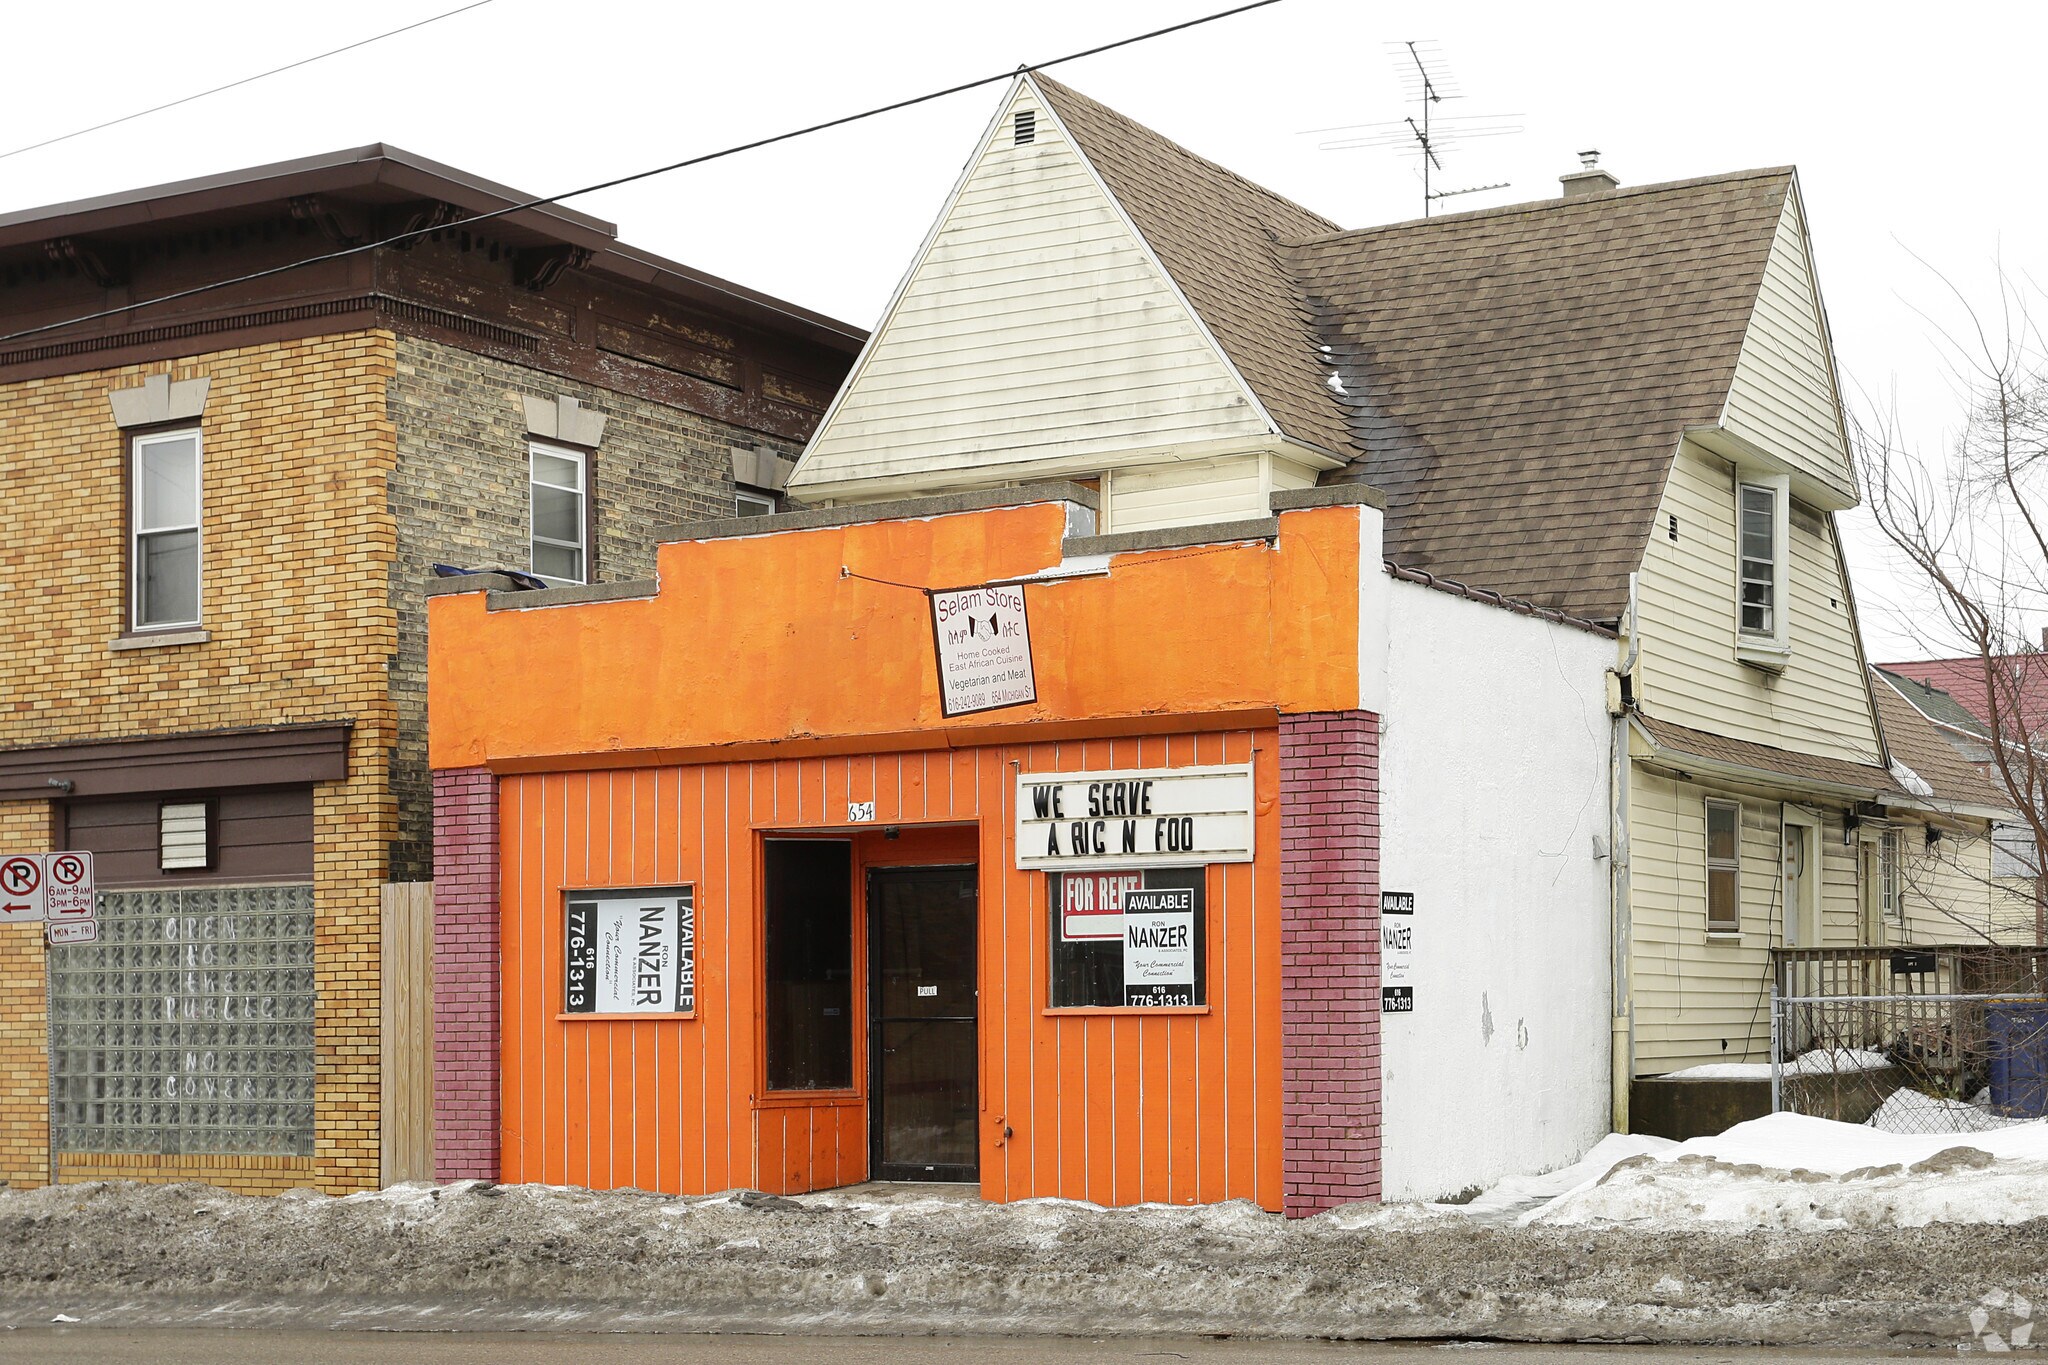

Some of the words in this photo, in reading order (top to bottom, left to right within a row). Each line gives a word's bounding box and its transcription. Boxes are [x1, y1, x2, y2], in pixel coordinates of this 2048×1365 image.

[938, 592, 982, 622] Selam
[985, 588, 1022, 612] Store
[949, 662, 966, 672] East
[968, 658, 994, 669] African
[996, 654, 1023, 665] Cuisine
[957, 651, 980, 661] Home
[981, 645, 1010, 657] Cooked
[949, 676, 990, 692] Vegetarian
[992, 672, 1006, 683] and
[1007, 668, 1027, 681] Meat
[991, 690, 1002, 704] 654
[1033, 785, 1065, 818] WE
[1088, 781, 1154, 817] SERVE
[849, 803, 872, 822] 654
[1048, 822, 1060, 856] A
[1122, 819, 1136, 853] N
[1155, 817, 1194, 851] FOO
[1066, 877, 1094, 912] FOR
[1128, 894, 1189, 910] AVAILABLE
[1383, 895, 1413, 911] AVAILABLE
[54, 928, 69, 937] MON
[81, 926, 92, 935] FRI
[166, 916, 235, 940] OPEN
[1129, 924, 1188, 948] NANZER
[1383, 925, 1412, 950] NANZER
[569, 911, 586, 1006] 776-1313
[586, 947, 594, 969] 616
[636, 907, 665, 1006] NANZER
[661, 945, 669, 968] RON
[680, 906, 693, 1006] AVAILABLE
[1150, 960, 1184, 969] Commercial
[613, 945, 622, 1001] Commercial
[1130, 994, 1188, 1007] 776-1313
[1152, 986, 1166, 994] 616
[1384, 997, 1412, 1011] 776-1313
[186, 1051, 214, 1072] NO
[167, 1076, 253, 1099] COVER
